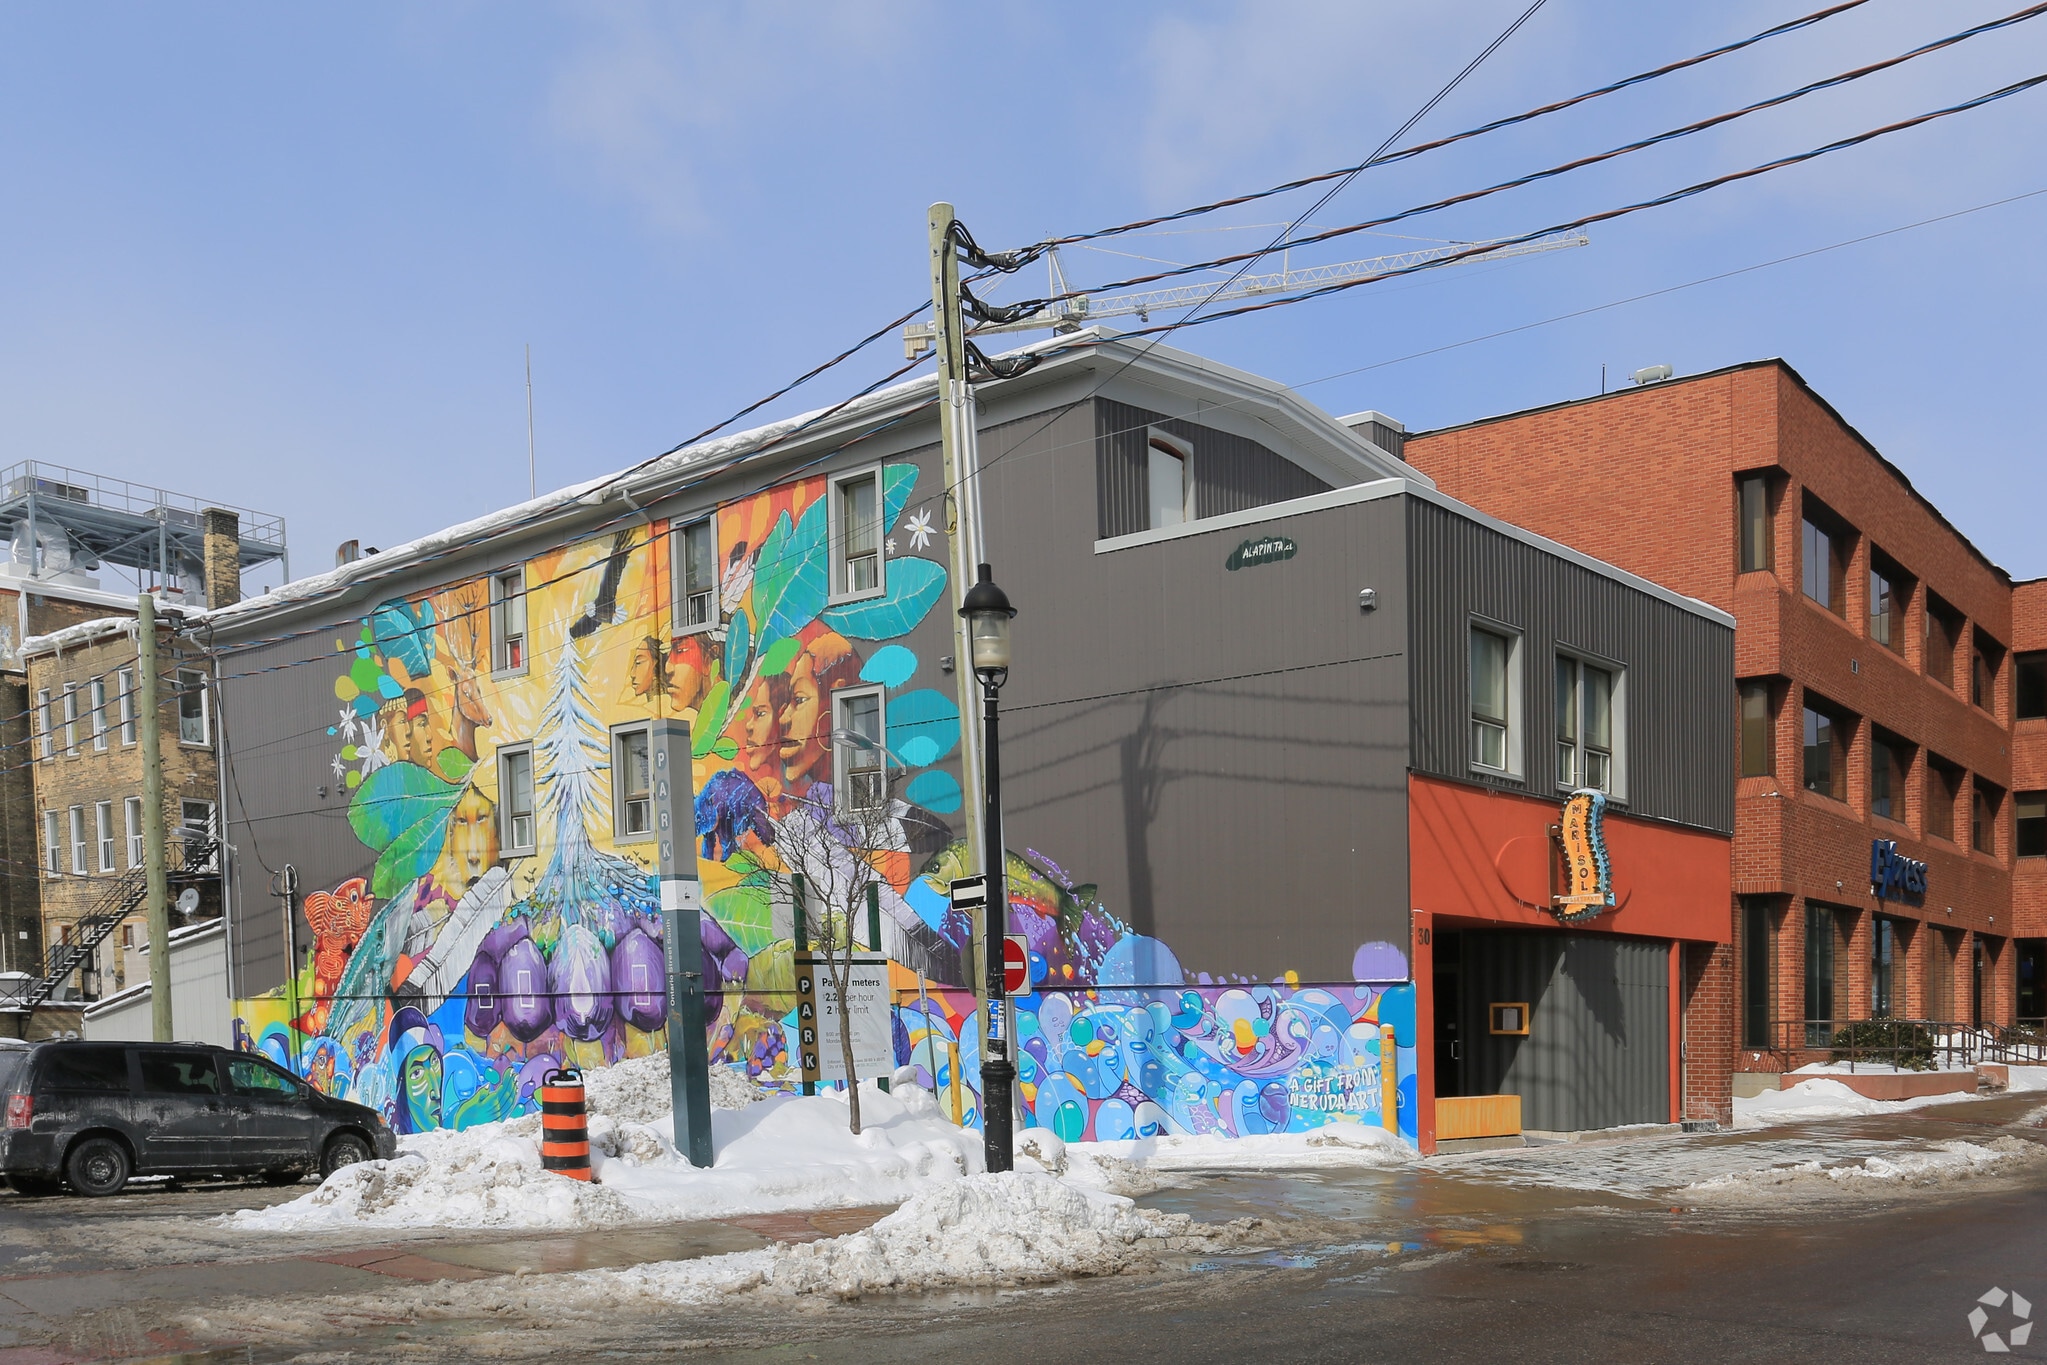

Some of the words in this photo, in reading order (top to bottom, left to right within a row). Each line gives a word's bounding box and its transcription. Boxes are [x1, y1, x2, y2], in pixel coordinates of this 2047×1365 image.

[658, 752, 671, 857] PARK
[1418, 928, 1430, 946] 30
[852, 978, 880, 987] meters
[858, 992, 874, 1002] hour
[826, 1005, 832, 1015] 2
[853, 1004, 869, 1014] limit
[802, 980, 814, 1068] PARK
[1290, 1078, 1299, 1092] A
[1337, 1067, 1378, 1091] FROM
